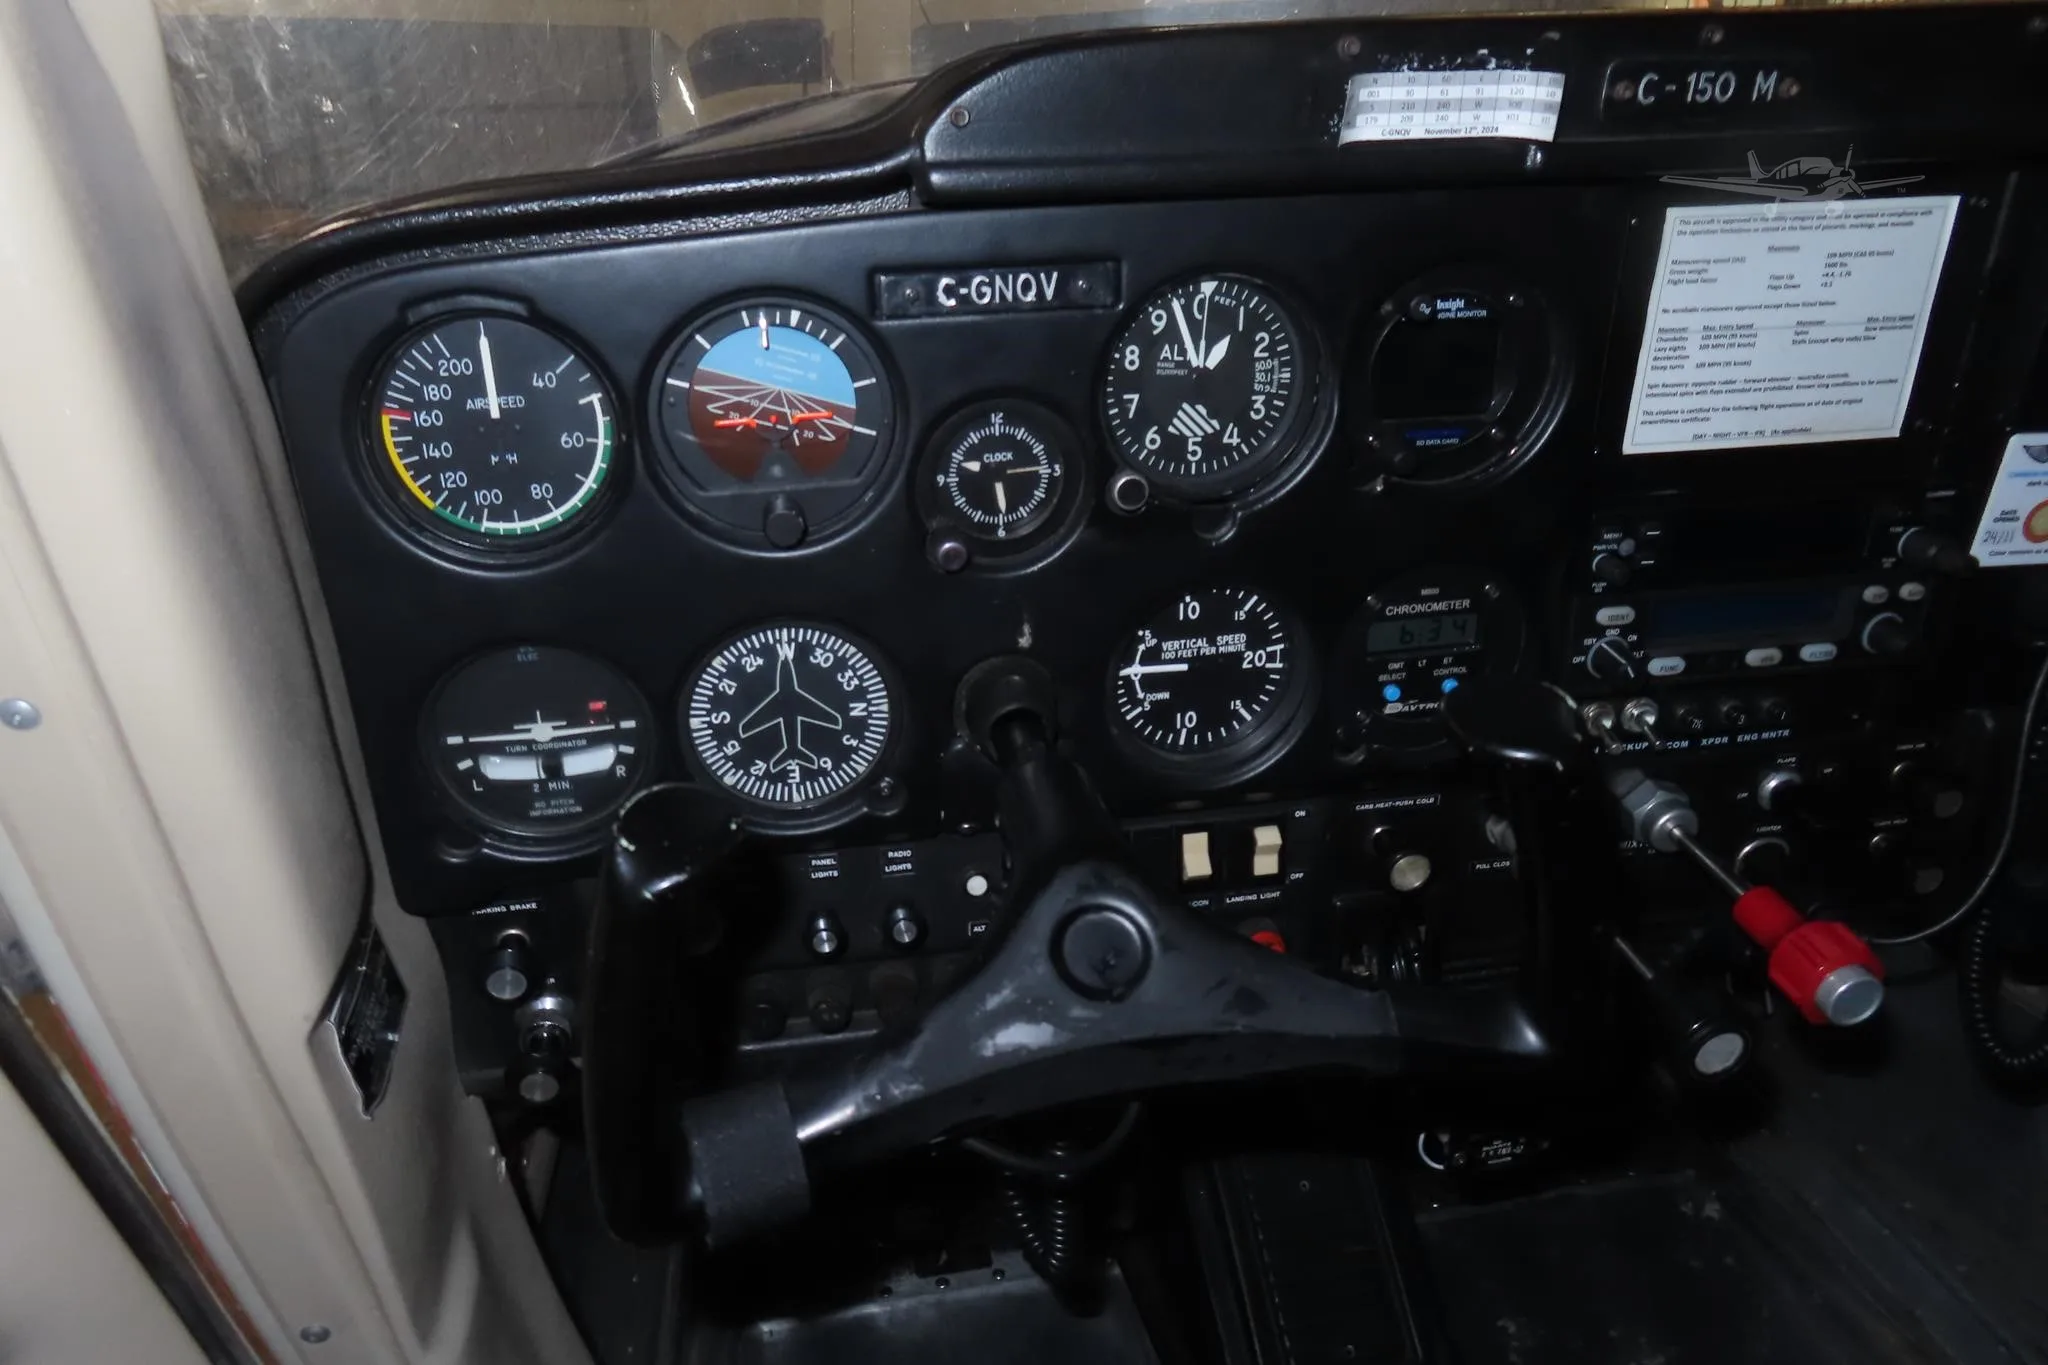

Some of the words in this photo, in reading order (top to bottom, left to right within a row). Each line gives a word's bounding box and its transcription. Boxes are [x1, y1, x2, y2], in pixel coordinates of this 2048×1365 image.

[1752, 70, 1778, 102] M
[1424, 127, 1462, 135] November
[936, 271, 1058, 307] C-GNQV
[1214, 295, 1237, 308] FEET
[1437, 298, 1464, 311] Insight
[1238, 305, 1245, 332] 1
[1457, 309, 1487, 318] MONITOR
[1151, 309, 1168, 336] 9
[1254, 331, 1270, 358] 2
[1124, 344, 1140, 371] 8
[438, 359, 473, 377] 200
[532, 371, 557, 388] 40
[423, 385, 451, 401] 180
[750, 399, 759, 408] 10
[1122, 393, 1140, 419] 7
[1250, 395, 1266, 420] 3
[414, 410, 444, 427] 160
[729, 411, 739, 419] 20
[560, 431, 584, 448] 60
[803, 429, 814, 439] 20
[1145, 425, 1161, 450] 6
[1222, 422, 1241, 447] 4
[422, 442, 452, 458] 140
[1187, 437, 1202, 461] 5
[984, 451, 1014, 463] CLOCK
[1053, 464, 1061, 476] 3
[440, 471, 468, 488] 120
[936, 475, 944, 487] 9
[475, 489, 503, 505] 100
[530, 483, 553, 500] 80
[998, 526, 1006, 537] 6
[1178, 601, 1200, 621] 10
[1385, 599, 1471, 616] CHRONOMETER
[1234, 610, 1246, 621] 15
[1145, 630, 1152, 641] 5
[1606, 628, 1620, 636] GND
[1627, 634, 1638, 642] ON
[1146, 637, 1158, 648] UP
[1162, 637, 1209, 652] VERTICAL
[1216, 633, 1247, 646] SPEED
[776, 643, 795, 661] W
[809, 648, 834, 668] 30
[1161, 651, 1176, 660] 100
[1177, 648, 1198, 659] FEET
[1200, 647, 1216, 656] PER
[1218, 643, 1246, 655] MINUTE
[741, 653, 764, 673] 24
[1242, 650, 1267, 669] 20
[1388, 661, 1405, 670] GMT
[1418, 659, 1427, 667] LT
[1572, 655, 1586, 664] OFF
[1378, 672, 1407, 682] SELECT
[1433, 666, 1467, 677] CONTROL
[718, 678, 738, 696] 21
[837, 669, 860, 692] 33
[1145, 691, 1170, 702] DOWN
[849, 702, 868, 717] N
[1144, 701, 1151, 711] 5
[1230, 700, 1242, 711] 15
[711, 711, 731, 724] S
[1176, 711, 1197, 729] 10
[842, 734, 859, 747] 3
[1701, 736, 1729, 746] XPDR
[1737, 733, 1758, 743] ENG
[1760, 728, 1790, 740] MNTR
[505, 744, 528, 753] TURN
[532, 739, 588, 751] COORDINATOR
[722, 740, 741, 757] 15
[749, 759, 768, 777] 12
[819, 757, 832, 771] 6
[615, 765, 627, 777] R
[786, 765, 800, 784] E
[472, 779, 484, 792] L
[533, 783, 540, 793] 2
[529, 806, 583, 817] INFORMATION
[888, 850, 912, 859] RADIO
[811, 857, 837, 866] PANEL
[885, 863, 912, 873] LIGHTS
[811, 870, 839, 879] LIGHTS
[1289, 872, 1304, 880] OFF
[1226, 894, 1258, 904] LANDING
[1260, 891, 1281, 900] LIGHT
[510, 902, 537, 911] BRAKE
[973, 924, 986, 933] ALT
